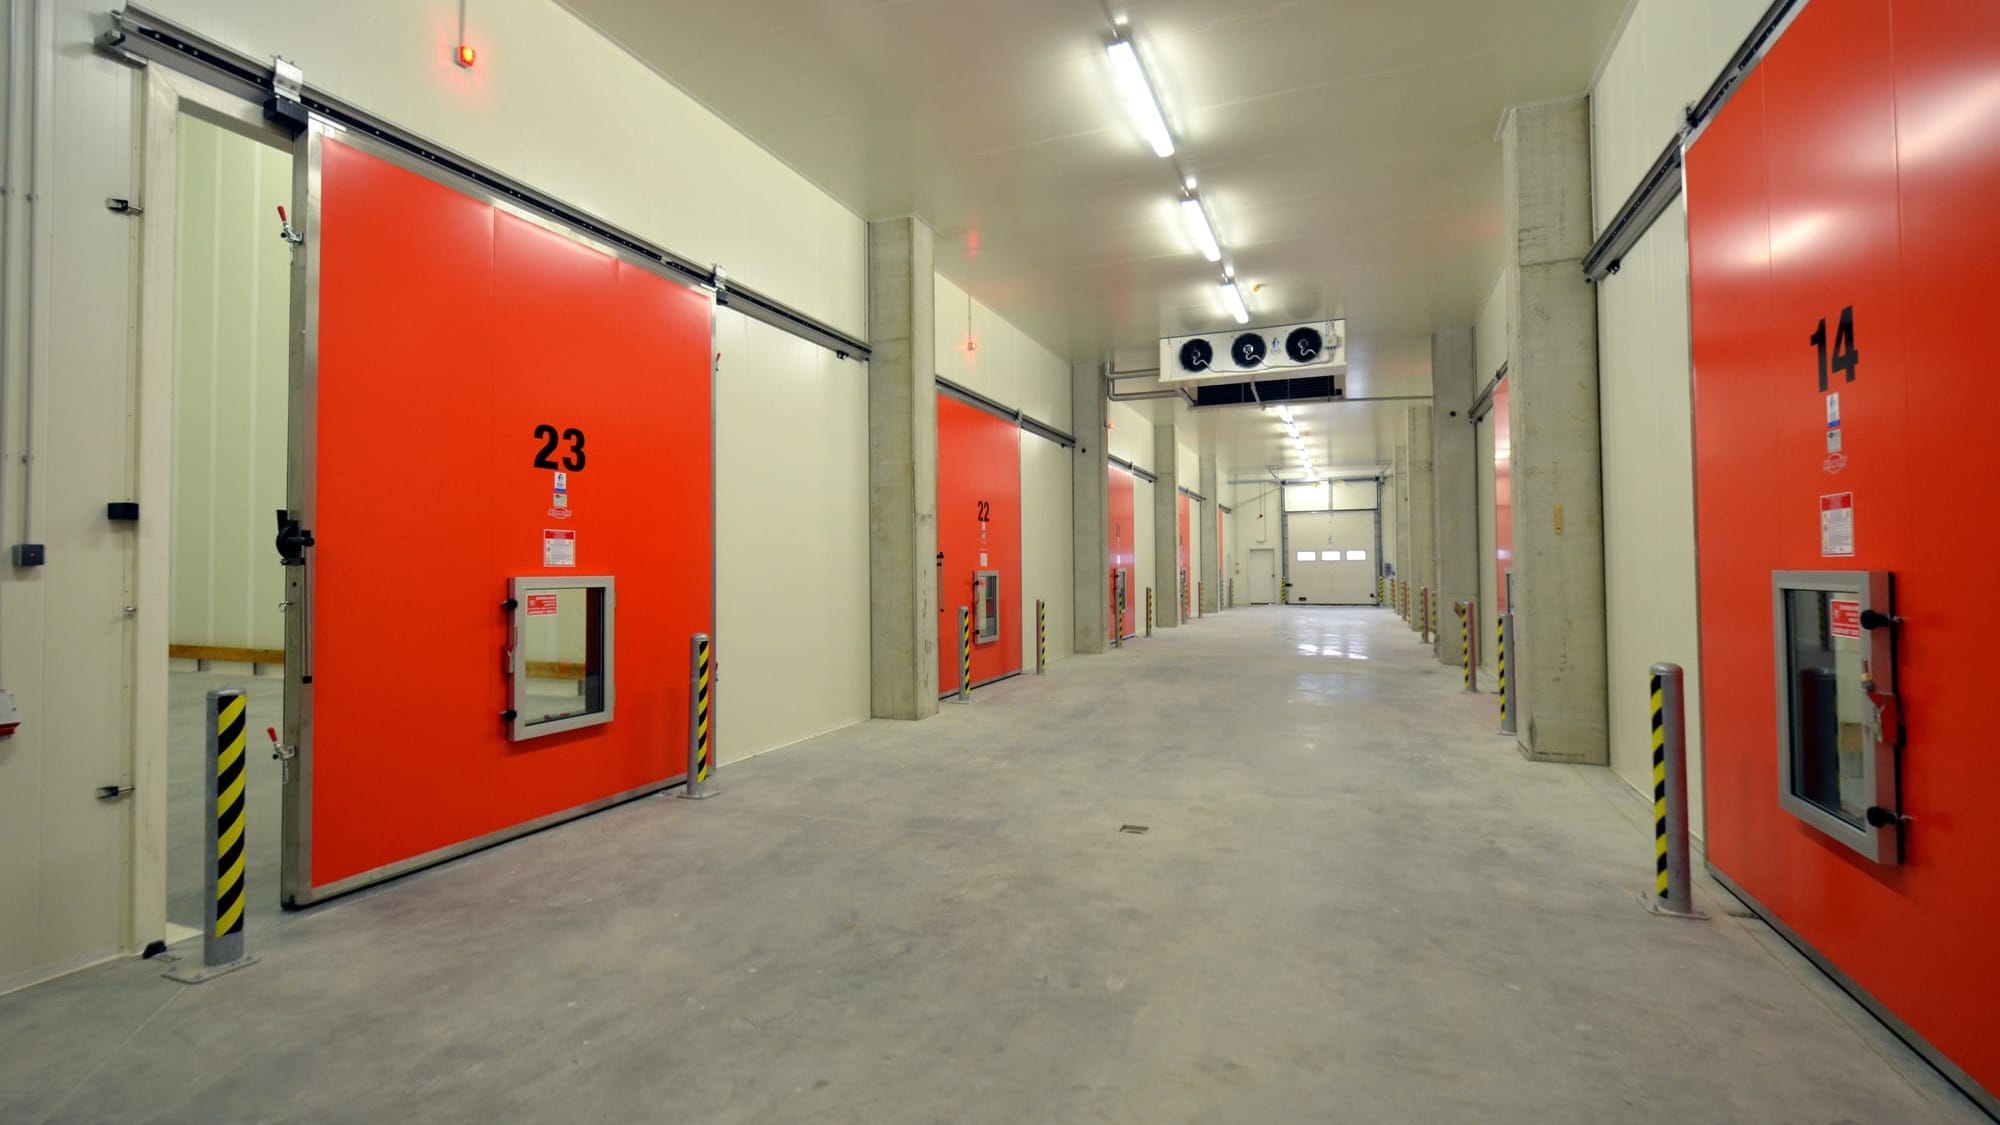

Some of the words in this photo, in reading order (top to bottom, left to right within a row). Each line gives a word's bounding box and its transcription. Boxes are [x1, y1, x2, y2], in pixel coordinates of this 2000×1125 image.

[1810, 305, 1859, 392] 14
[533, 424, 586, 472] 23
[977, 501, 990, 522] 22
